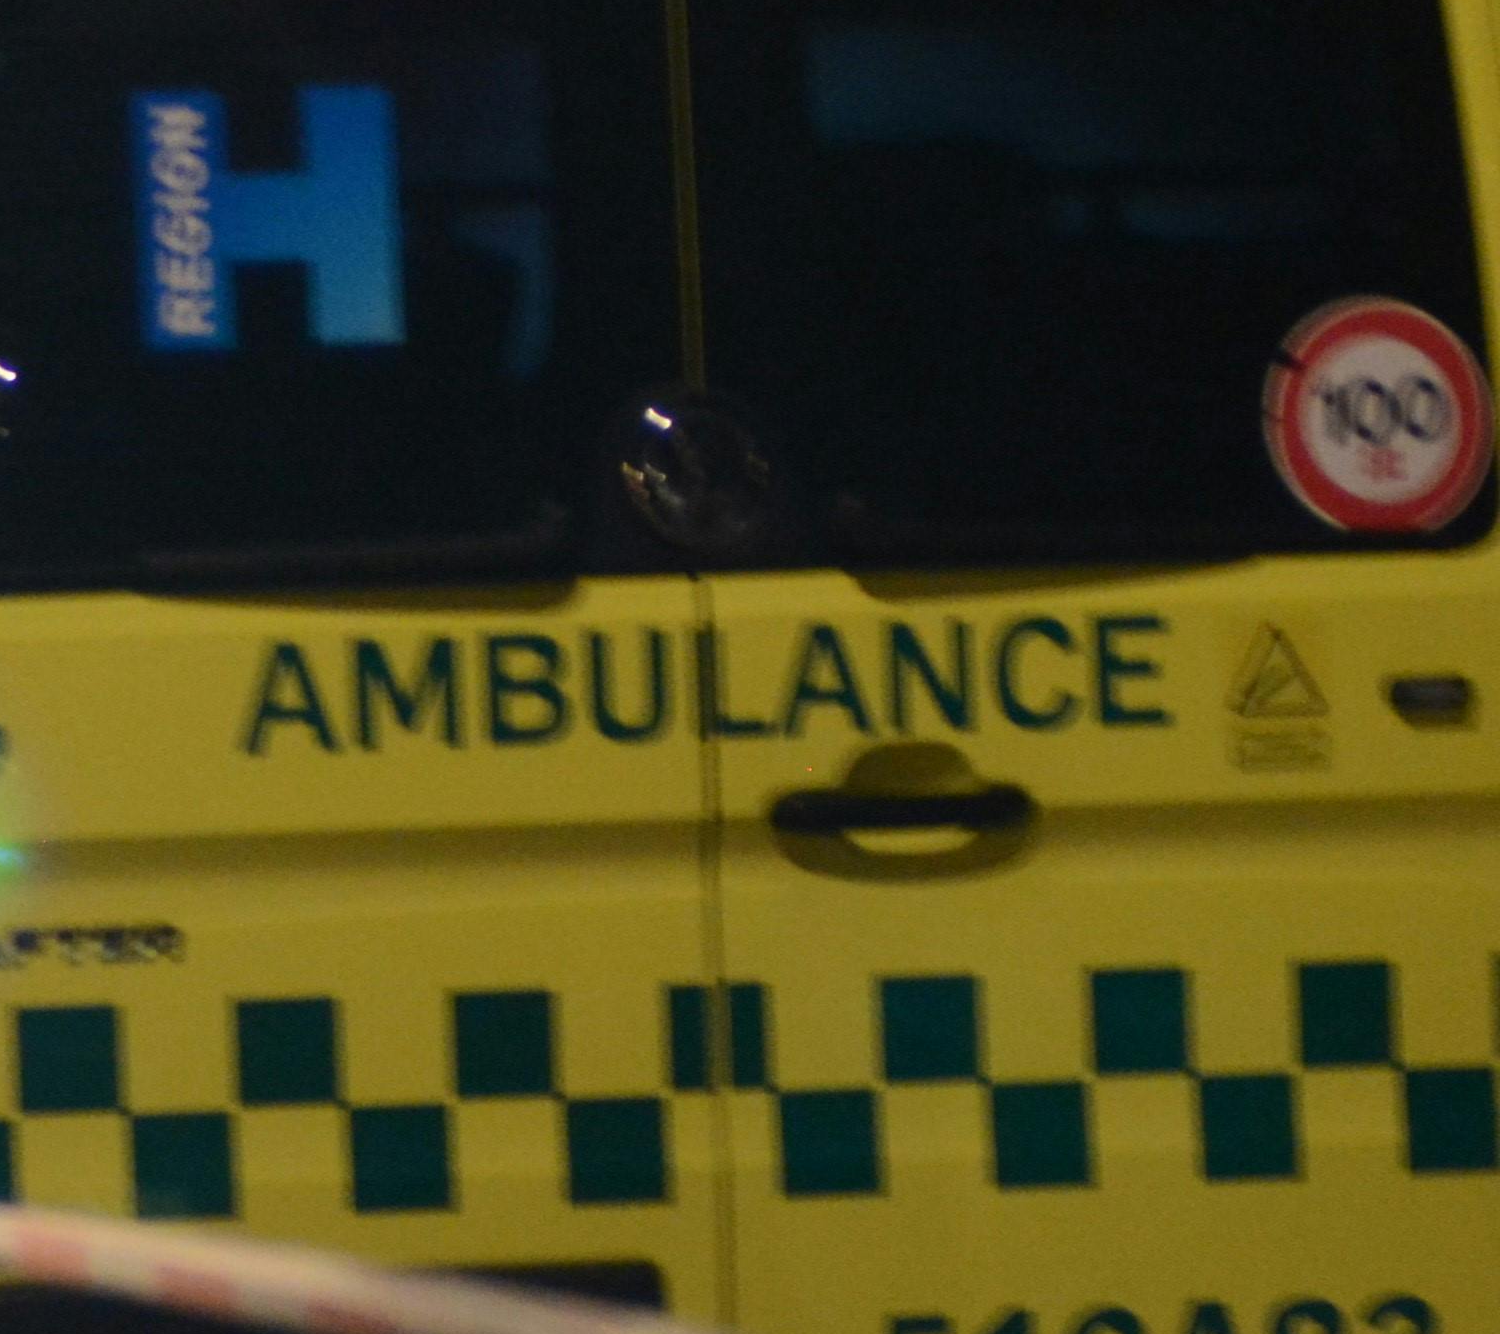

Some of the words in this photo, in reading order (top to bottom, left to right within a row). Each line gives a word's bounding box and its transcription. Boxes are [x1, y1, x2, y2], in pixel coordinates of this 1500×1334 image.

[151, 105, 215, 336] REGION
[1312, 375, 1452, 445] 100
[241, 614, 1173, 754] AMBULANCE
